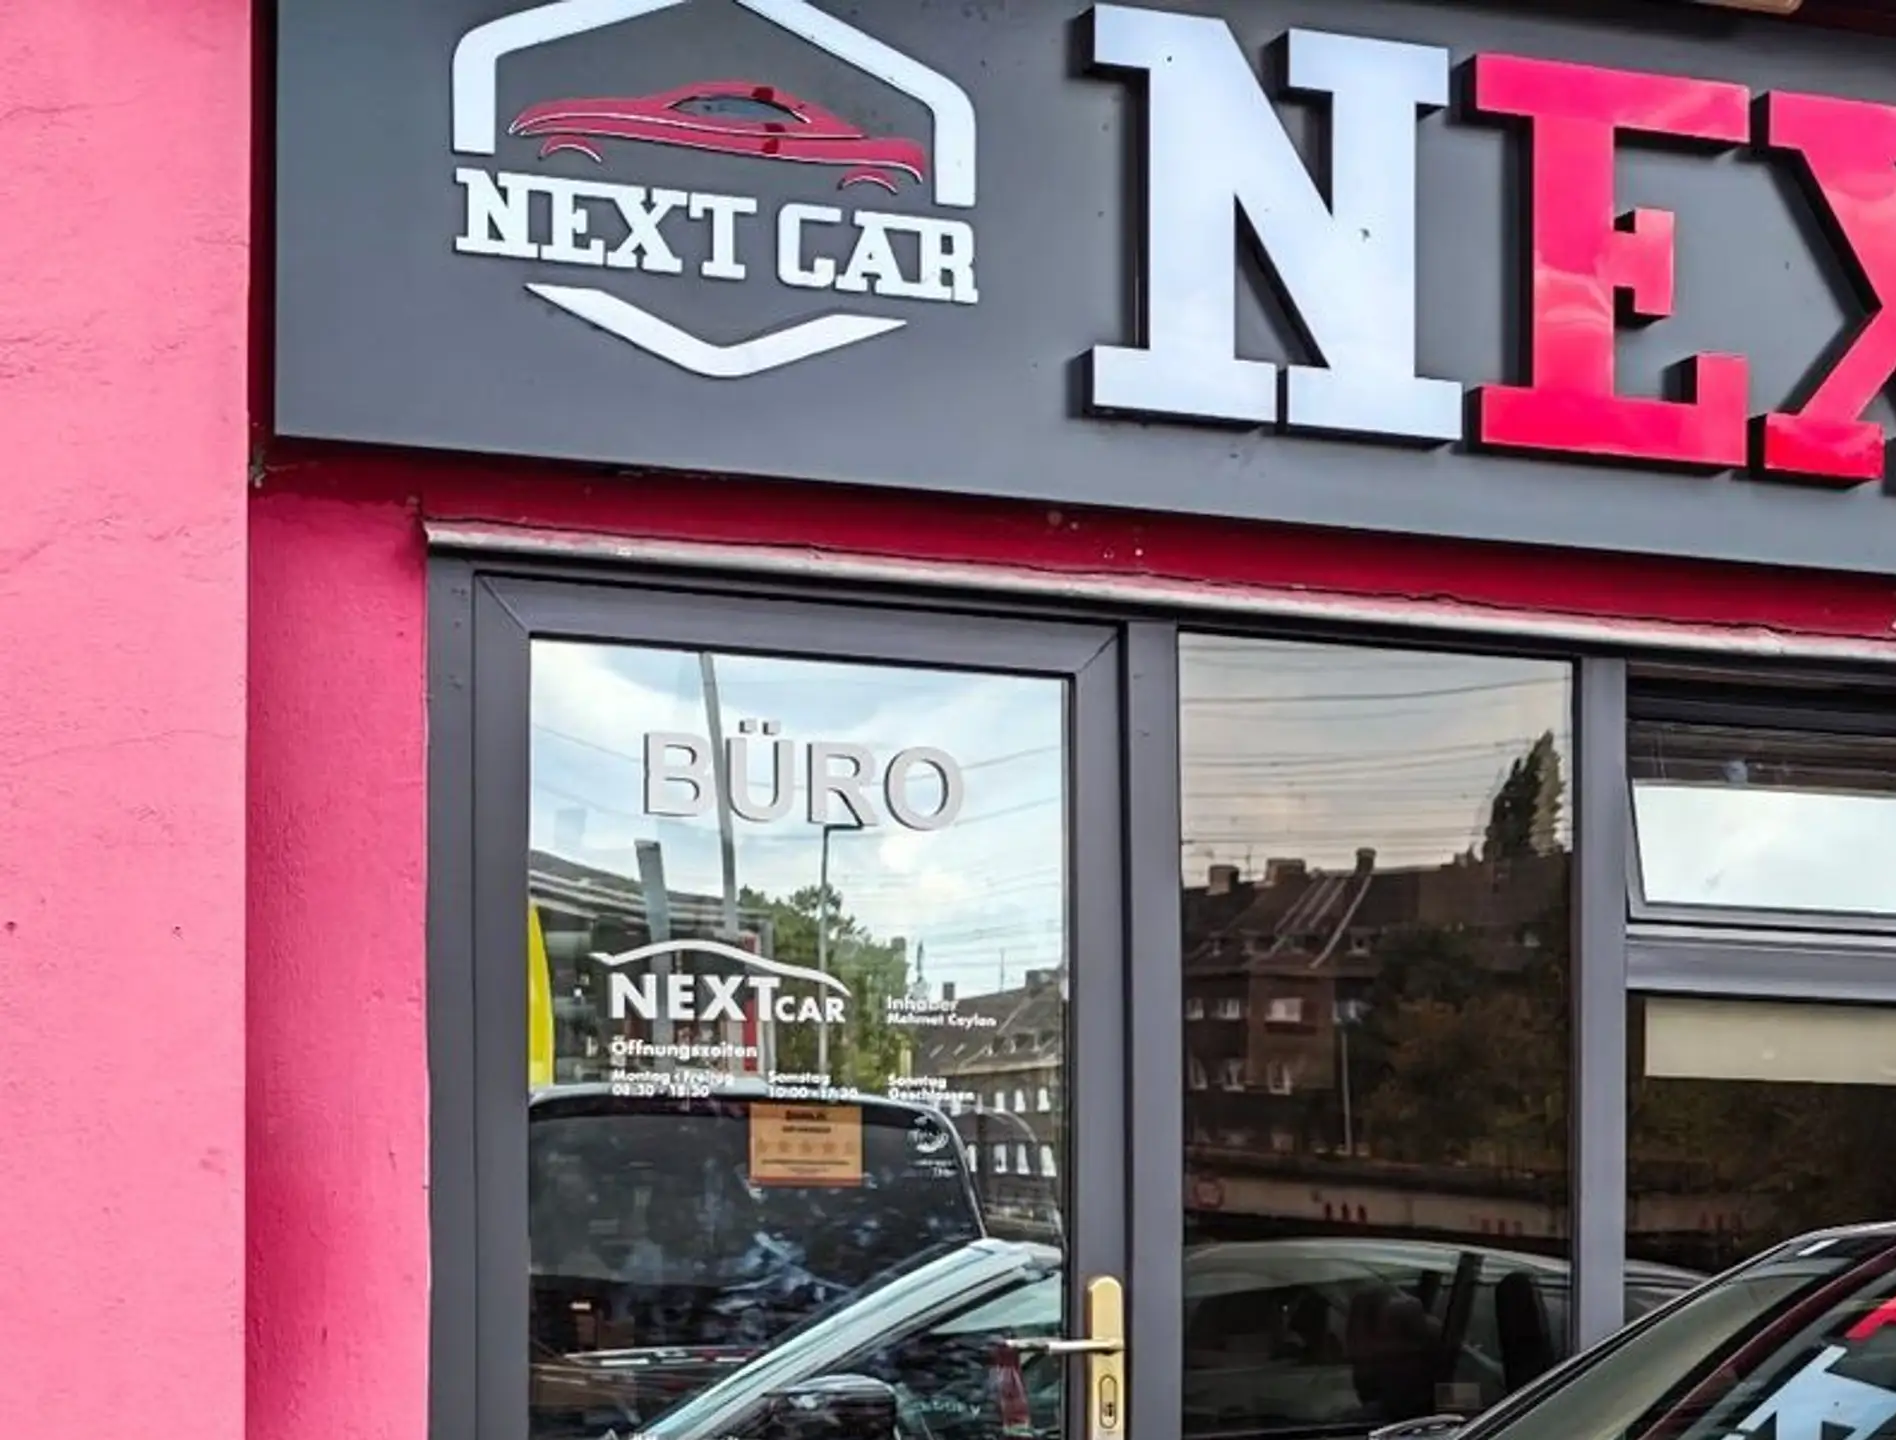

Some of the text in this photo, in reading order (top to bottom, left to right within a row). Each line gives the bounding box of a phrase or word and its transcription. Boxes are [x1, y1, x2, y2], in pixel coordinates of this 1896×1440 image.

[454, 166, 979, 305] NEXT CAR
[643, 718, 964, 831] BÜRO
[887, 993, 959, 1011] Inhaber
[611, 1036, 758, 1061] Öffnungszeiten
[768, 1069, 831, 1087] Samstag
